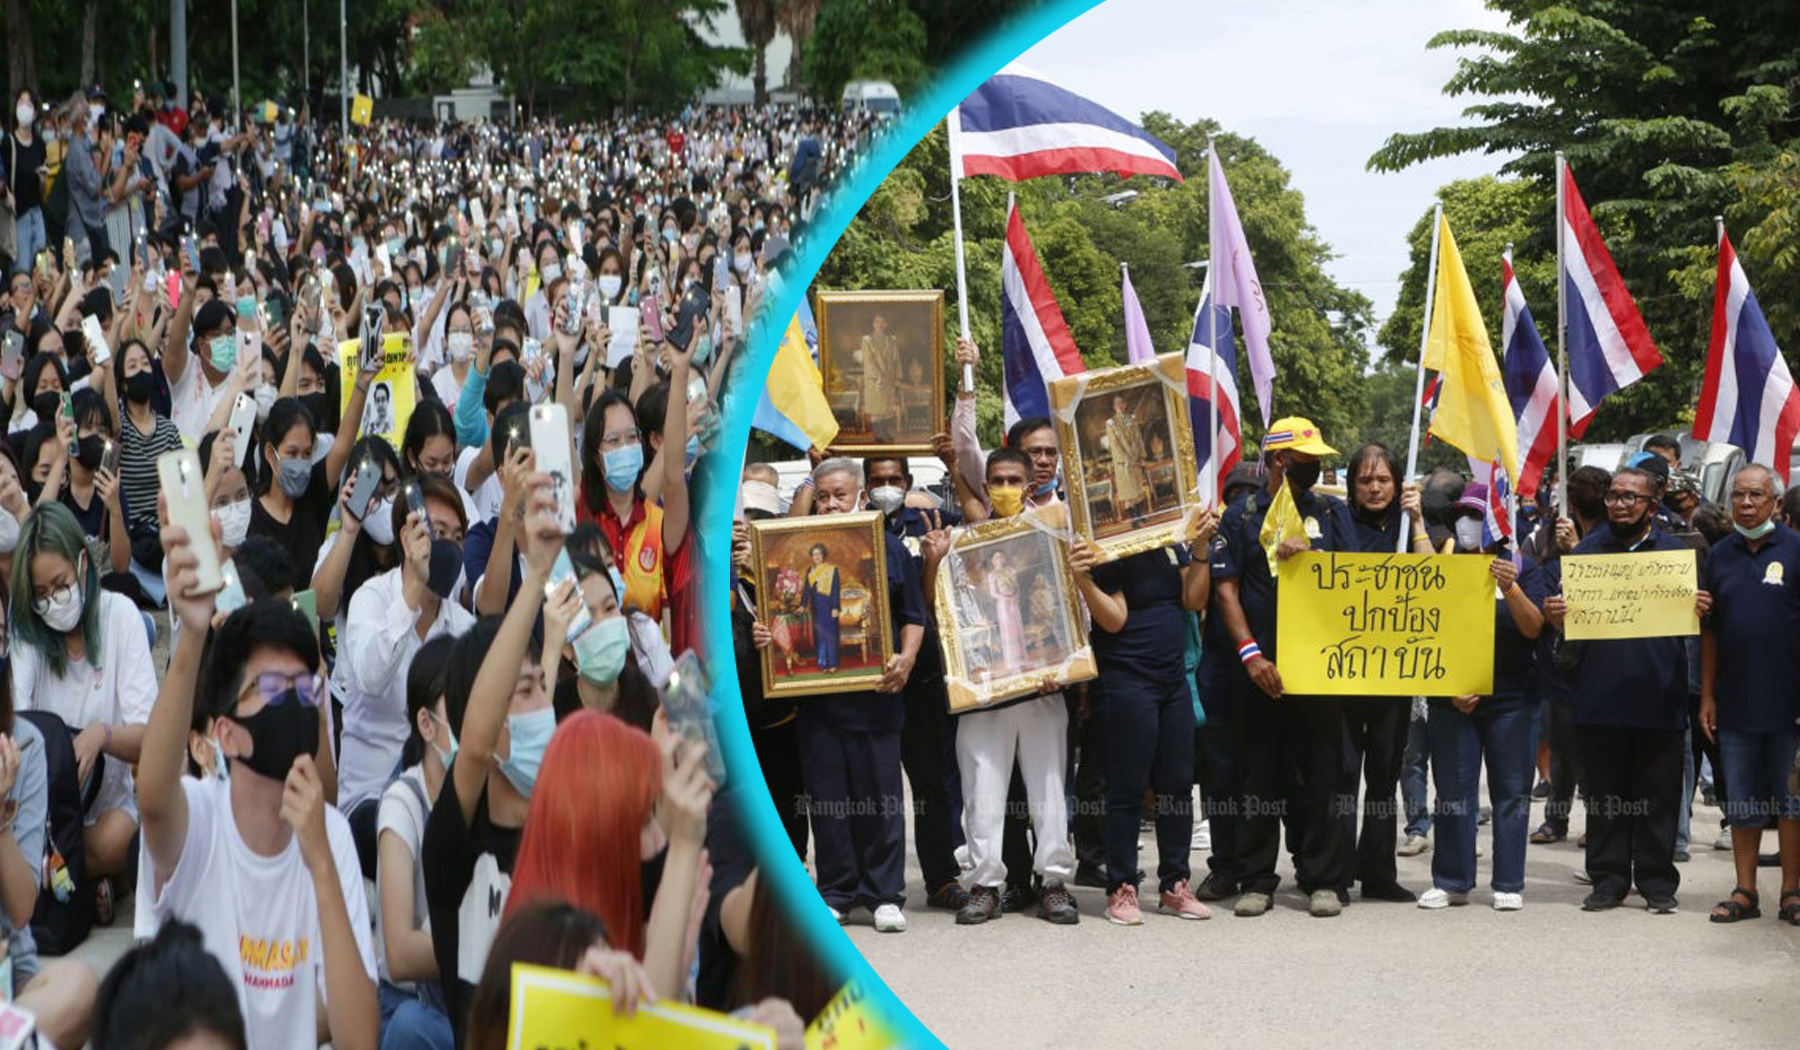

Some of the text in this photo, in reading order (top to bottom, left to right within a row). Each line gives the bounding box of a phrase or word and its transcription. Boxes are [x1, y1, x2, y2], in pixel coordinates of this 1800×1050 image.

[1312, 553, 1446, 591] ประชาชน
[1343, 590, 1441, 633] ปกป้อง
[1320, 635, 1446, 680] สถาบัน
